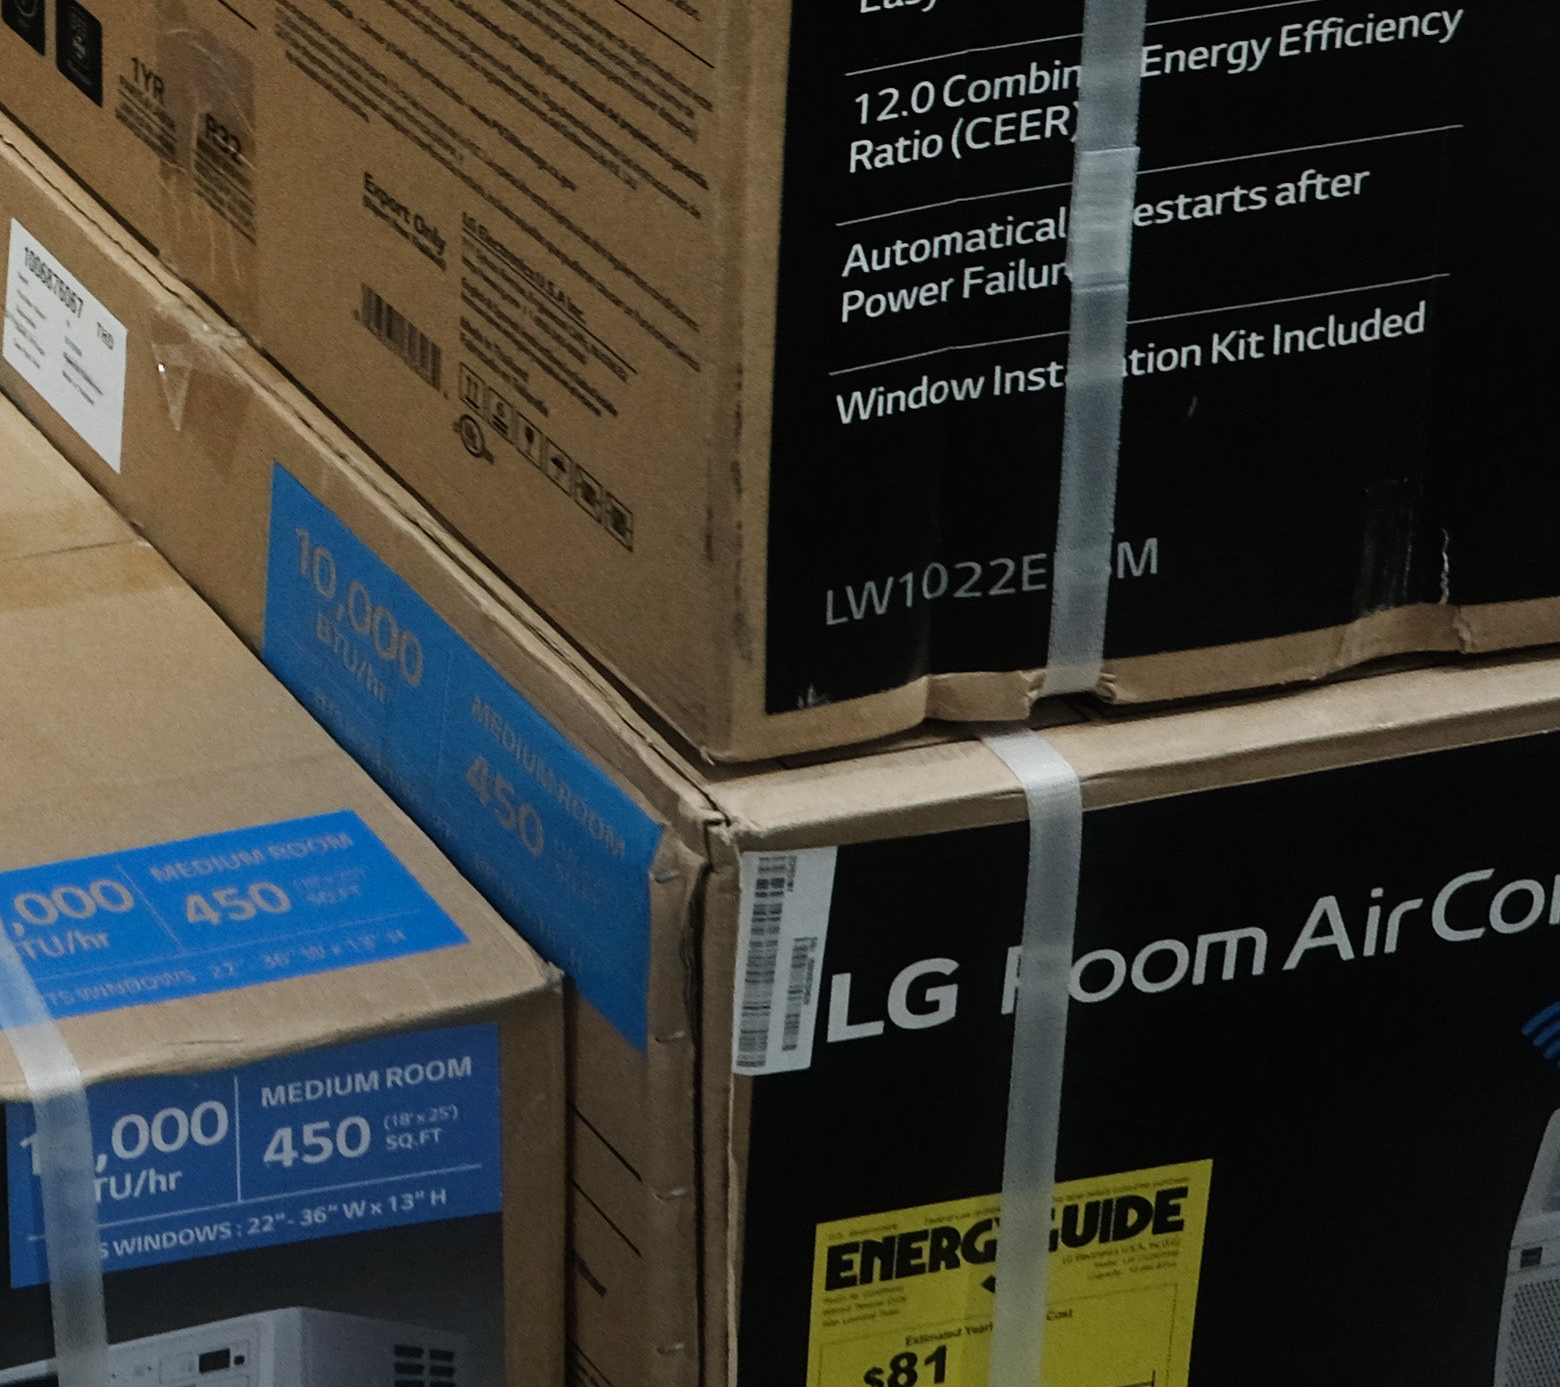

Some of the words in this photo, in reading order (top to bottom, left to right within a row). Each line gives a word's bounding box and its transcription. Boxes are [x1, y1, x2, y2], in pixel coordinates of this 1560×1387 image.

[827, 957, 959, 1043] LG
[260, 1069, 380, 1110] MEDIUM
[385, 1055, 473, 1088] ROOM
[263, 1115, 371, 1169] 450
[385, 1126, 443, 1153] SQ.FT
